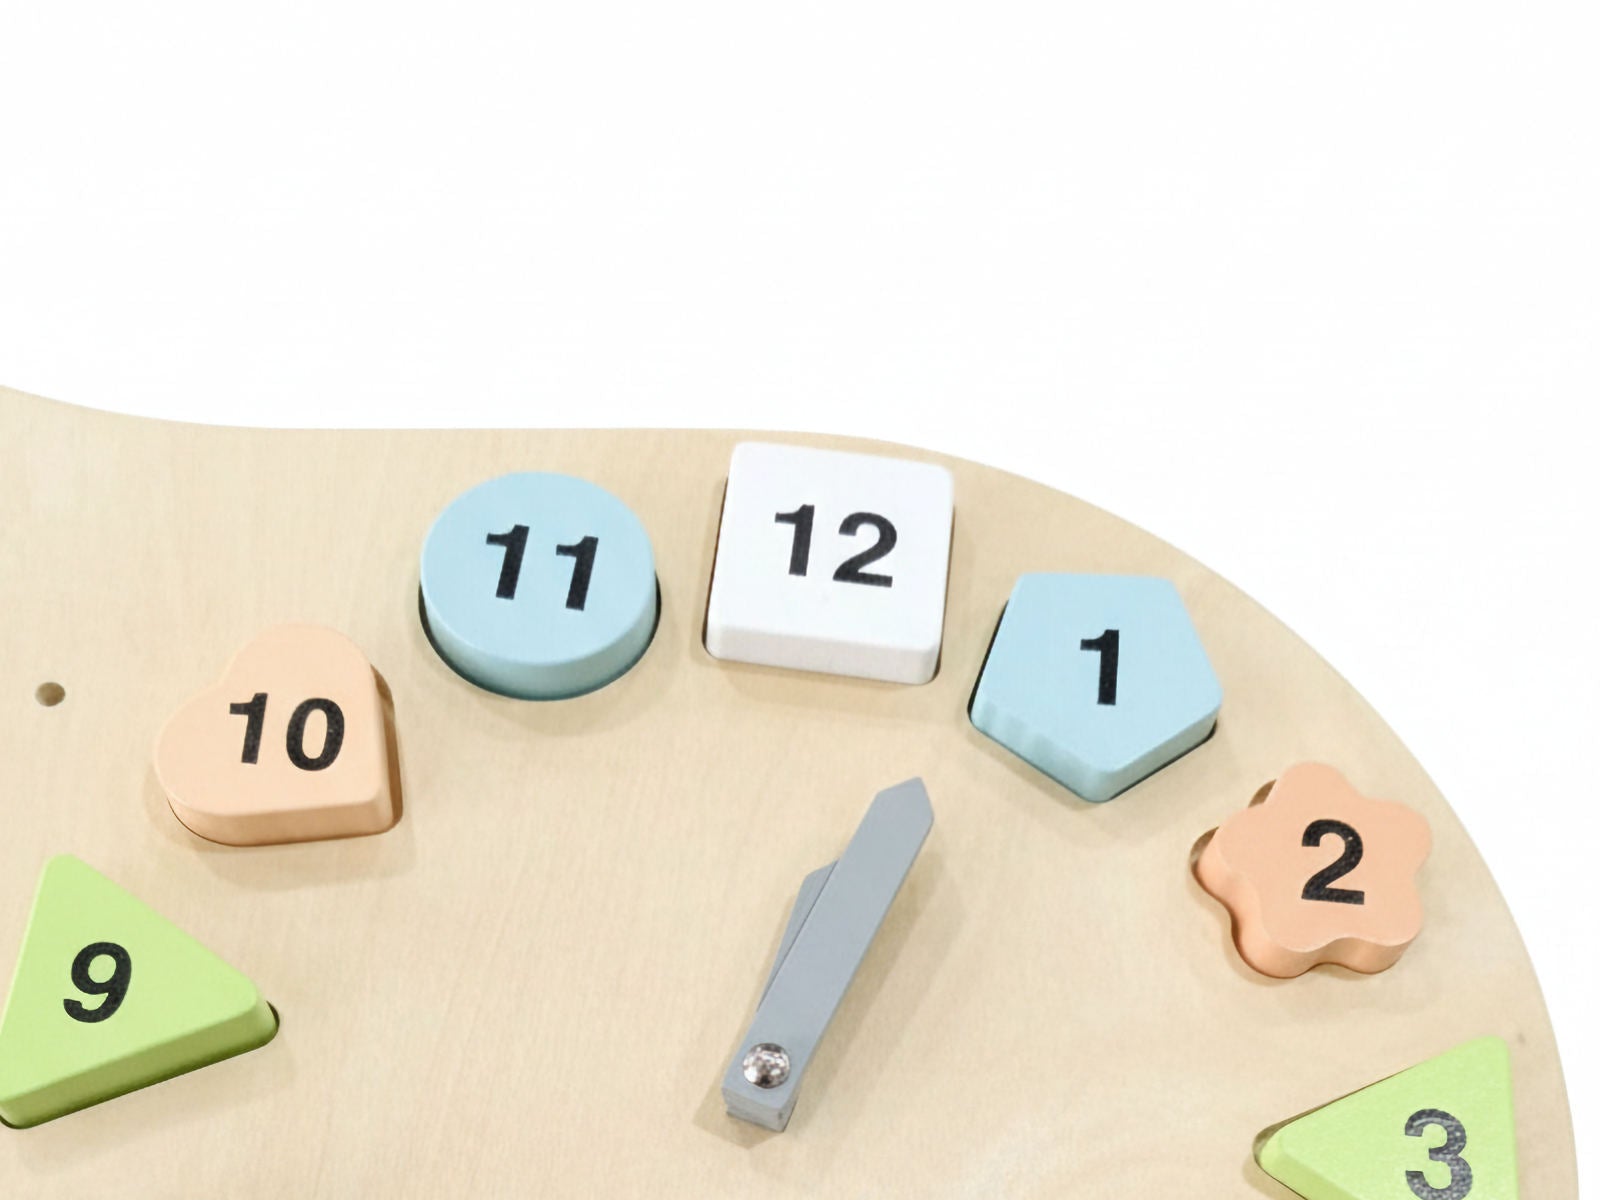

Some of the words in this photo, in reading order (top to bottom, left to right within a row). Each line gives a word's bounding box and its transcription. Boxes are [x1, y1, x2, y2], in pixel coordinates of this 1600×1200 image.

[486, 524, 599, 611] 11
[775, 504, 898, 588] 12
[1080, 629, 1120, 706] 1
[229, 692, 345, 771] 10
[1301, 819, 1366, 905] 2
[63, 941, 132, 1023] 9
